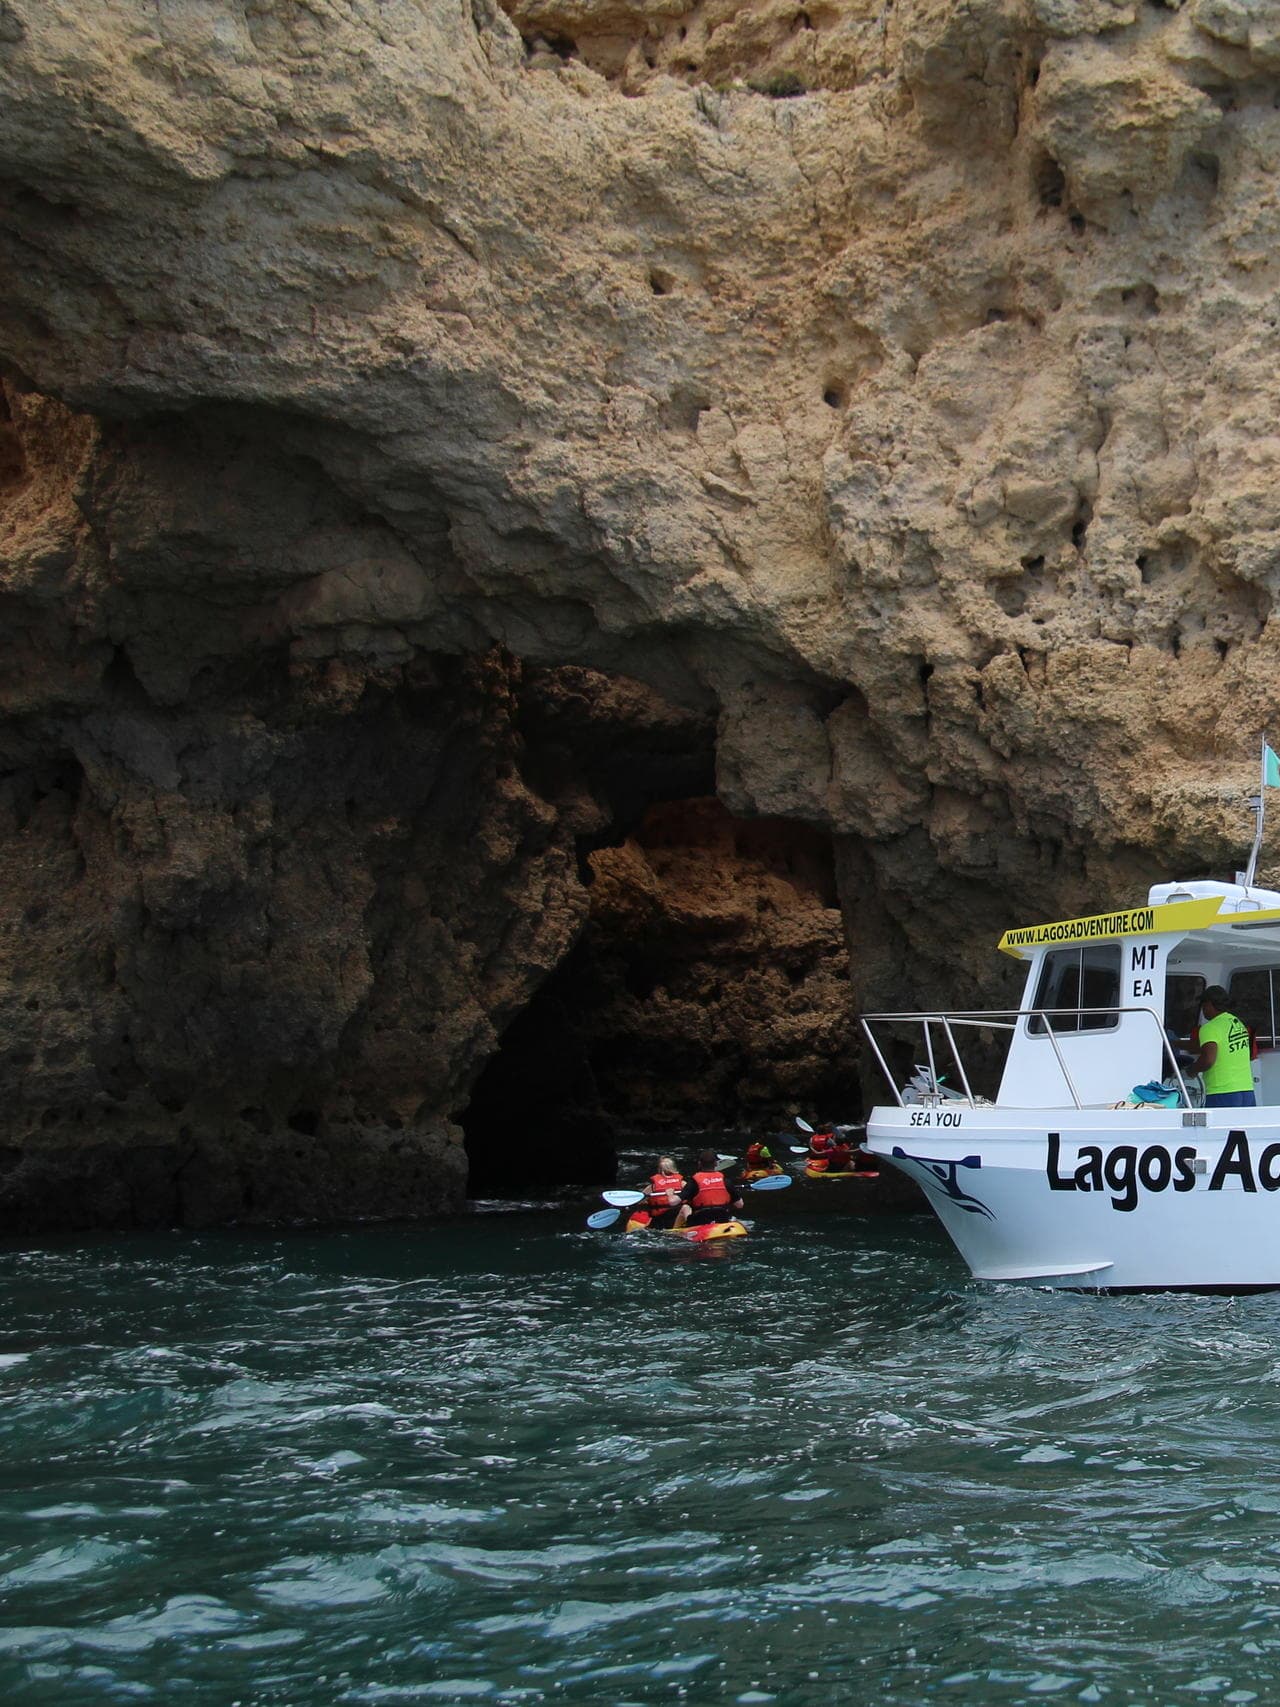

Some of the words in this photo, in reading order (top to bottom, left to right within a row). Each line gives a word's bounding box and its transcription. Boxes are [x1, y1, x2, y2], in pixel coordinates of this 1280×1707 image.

[1006, 910, 1154, 945] WWW.LAGOSADVENTURE.COM
[1131, 945, 1159, 971] MT
[1133, 979, 1153, 997] EA
[910, 1112, 931, 1126] SEA
[936, 1112, 962, 1127] YOU
[1046, 1132, 1197, 1212] Lagos
